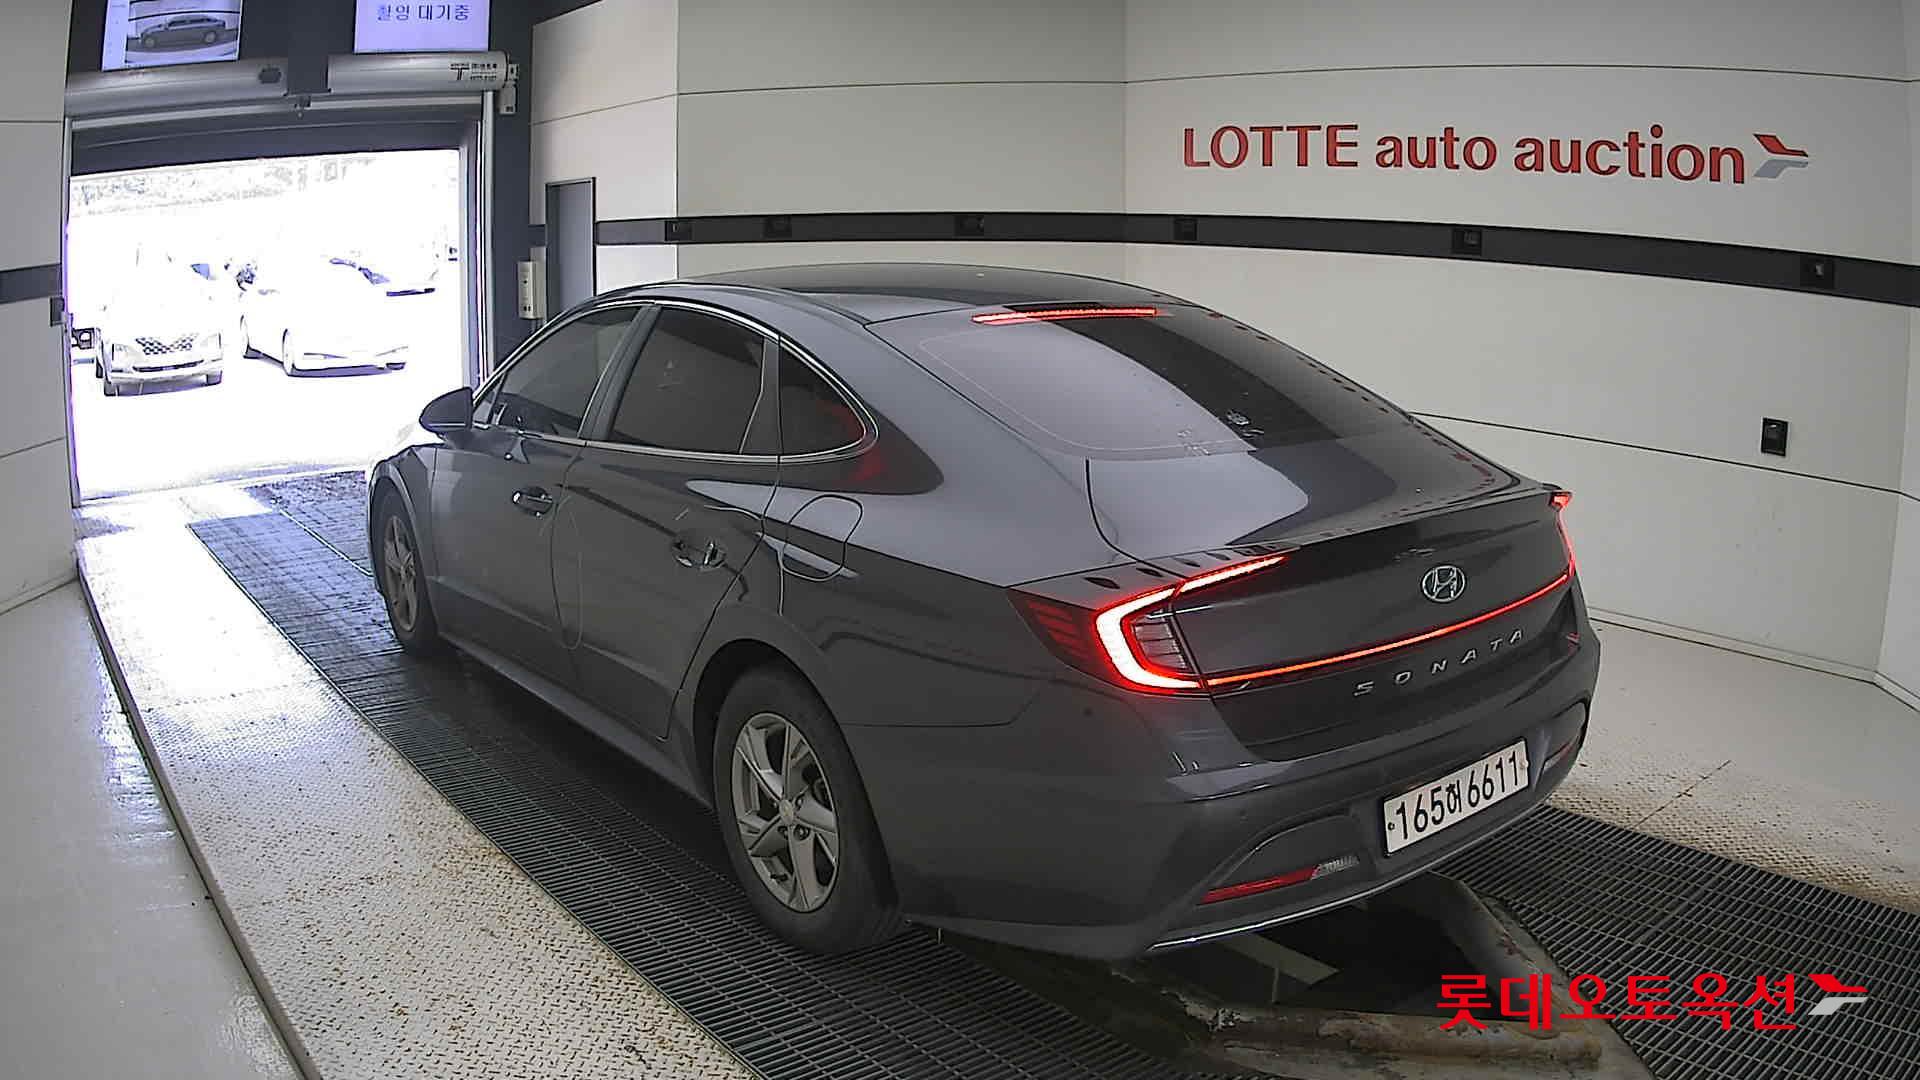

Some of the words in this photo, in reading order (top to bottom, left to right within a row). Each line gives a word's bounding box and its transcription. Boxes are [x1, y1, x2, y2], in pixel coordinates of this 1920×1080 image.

[418, 4, 471, 21] 대기중
[1183, 124, 1358, 168] LOTTE
[1375, 127, 1497, 170] auto
[1514, 124, 1745, 184] auction
[1353, 629, 1523, 696] SONATA
